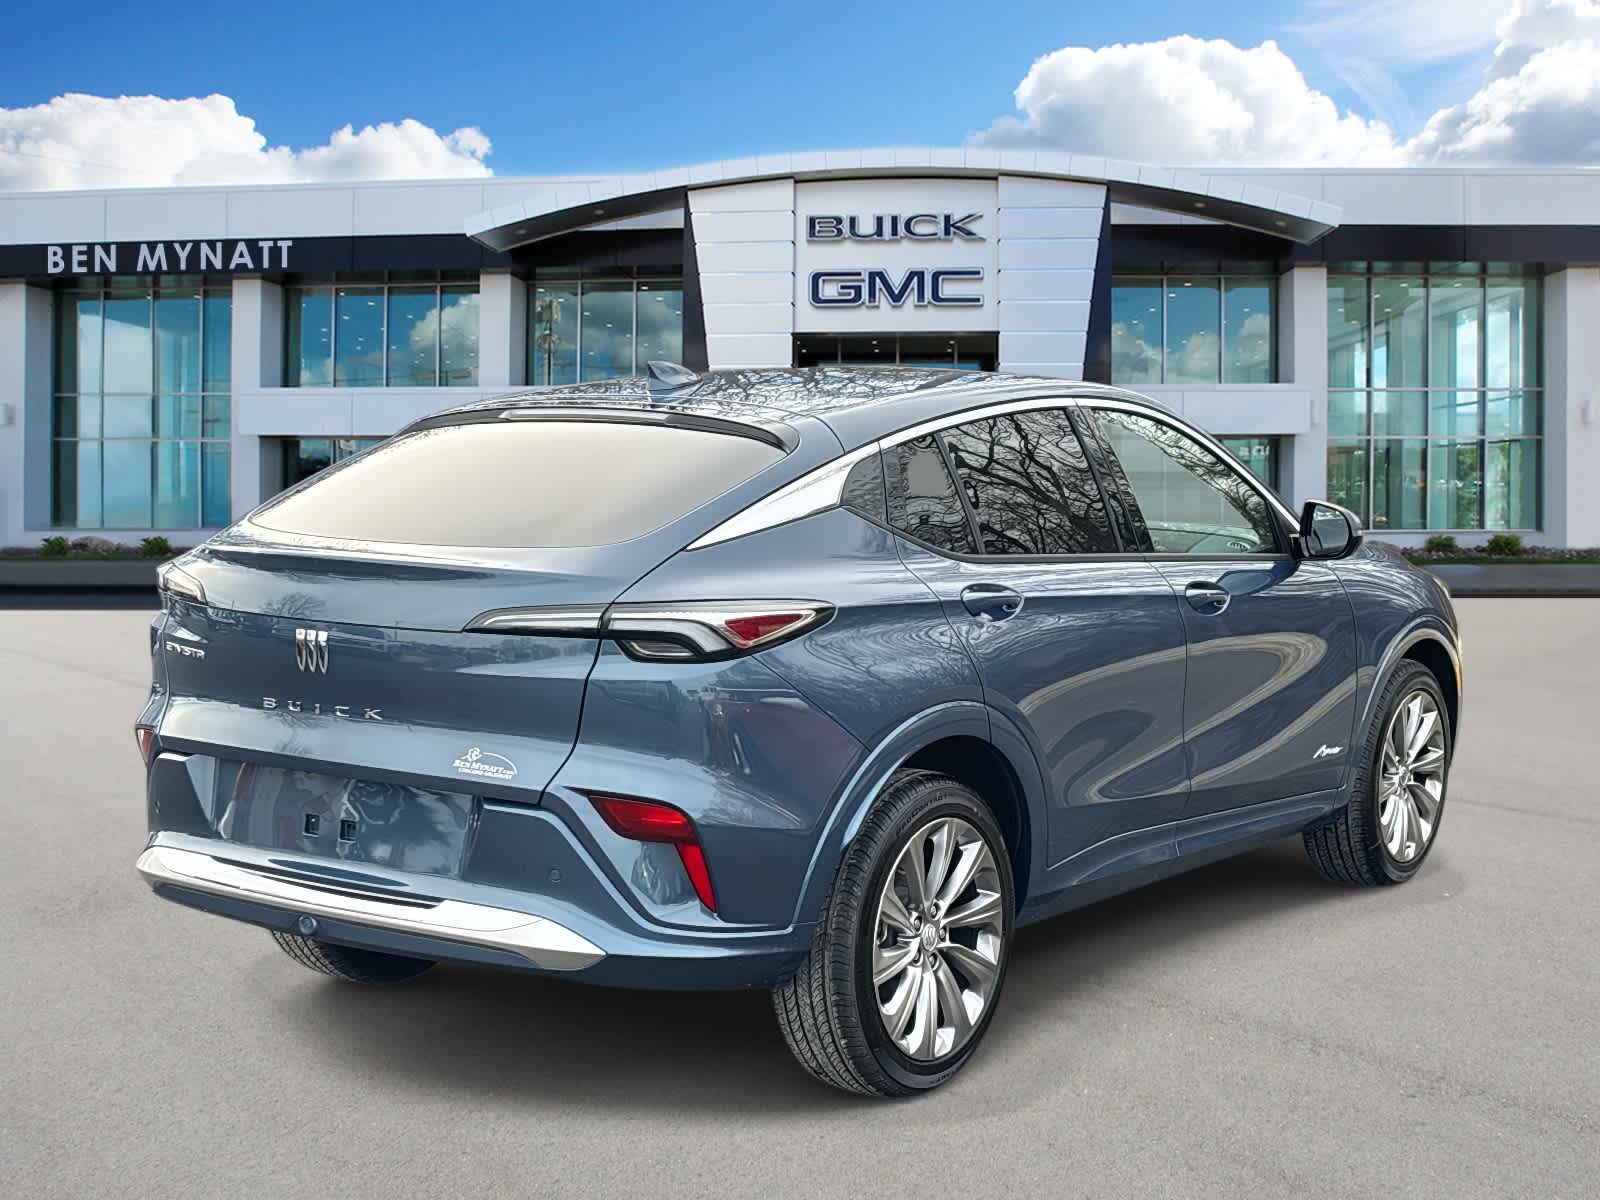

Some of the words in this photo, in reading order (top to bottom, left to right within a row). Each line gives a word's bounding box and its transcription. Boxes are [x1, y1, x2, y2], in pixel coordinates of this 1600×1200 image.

[806, 213, 986, 242] BUICK
[47, 244, 117, 274] BEN
[136, 240, 292, 272] MYNATT
[809, 267, 984, 308] GMC
[263, 697, 383, 720] BUICK
